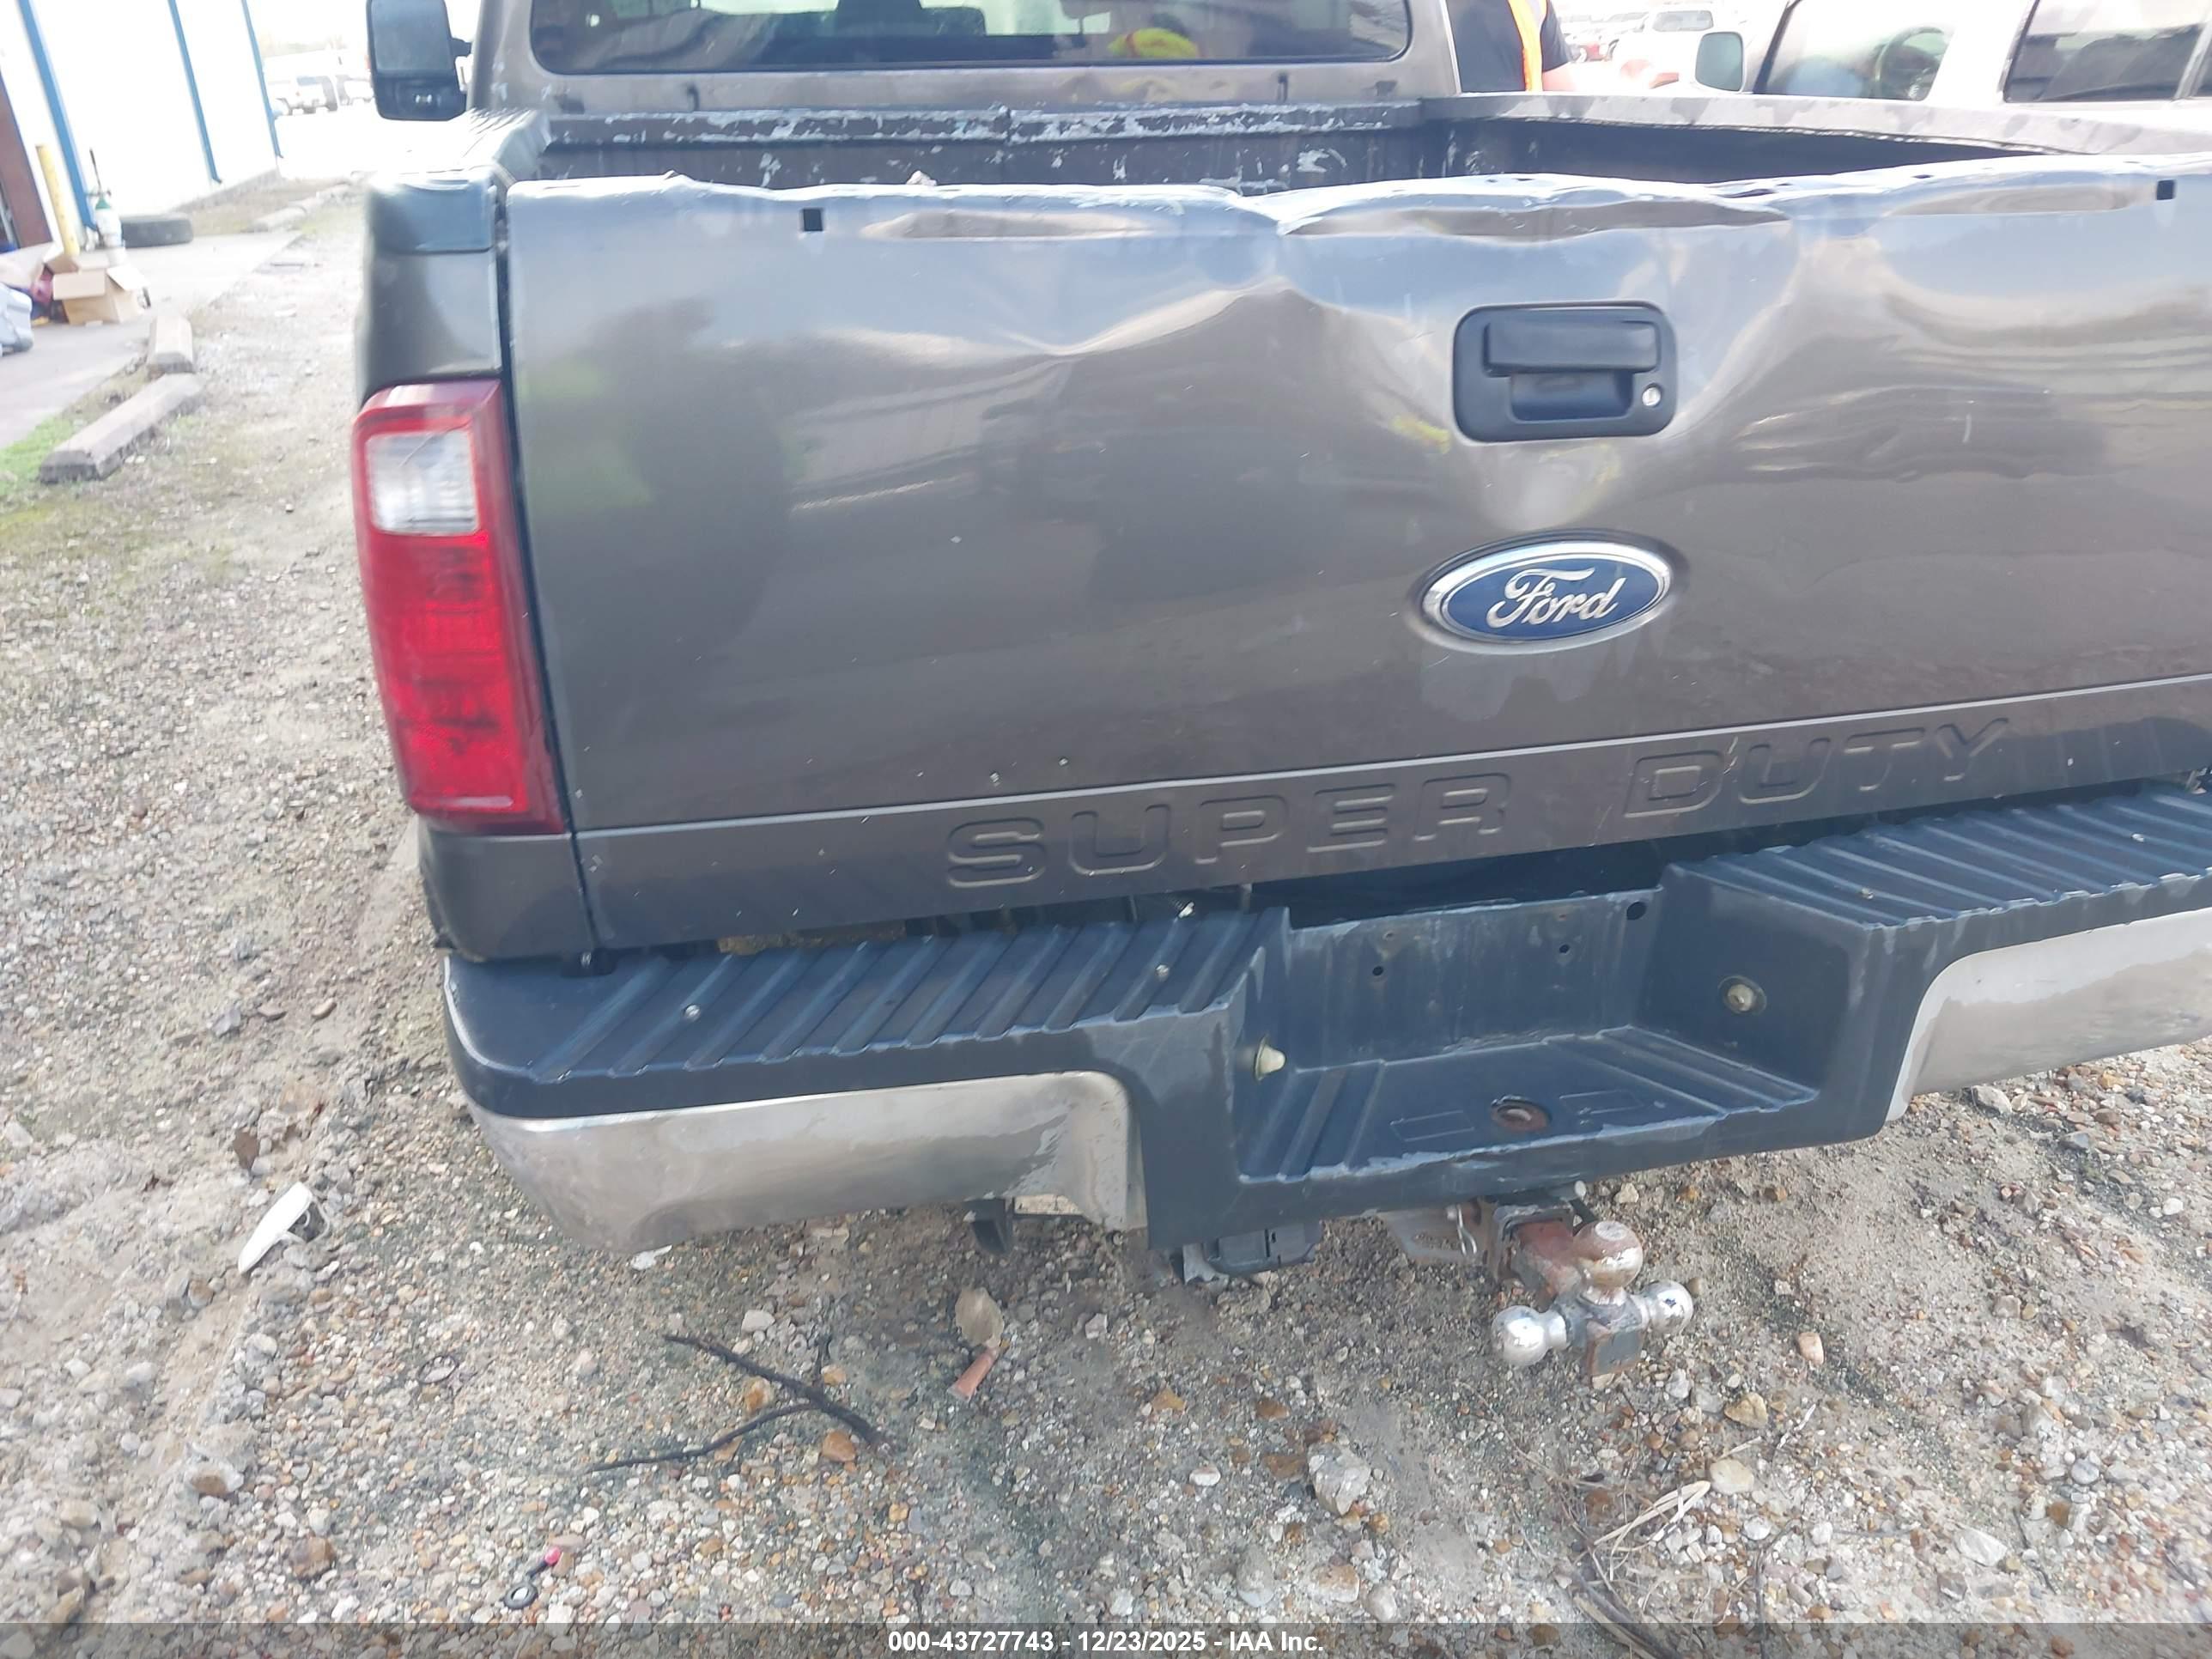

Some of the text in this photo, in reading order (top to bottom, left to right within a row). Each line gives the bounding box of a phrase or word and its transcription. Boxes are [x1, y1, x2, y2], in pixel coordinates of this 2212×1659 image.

[1486, 568, 1627, 629] Ford
[947, 717, 2010, 888] SUPER DUTY
